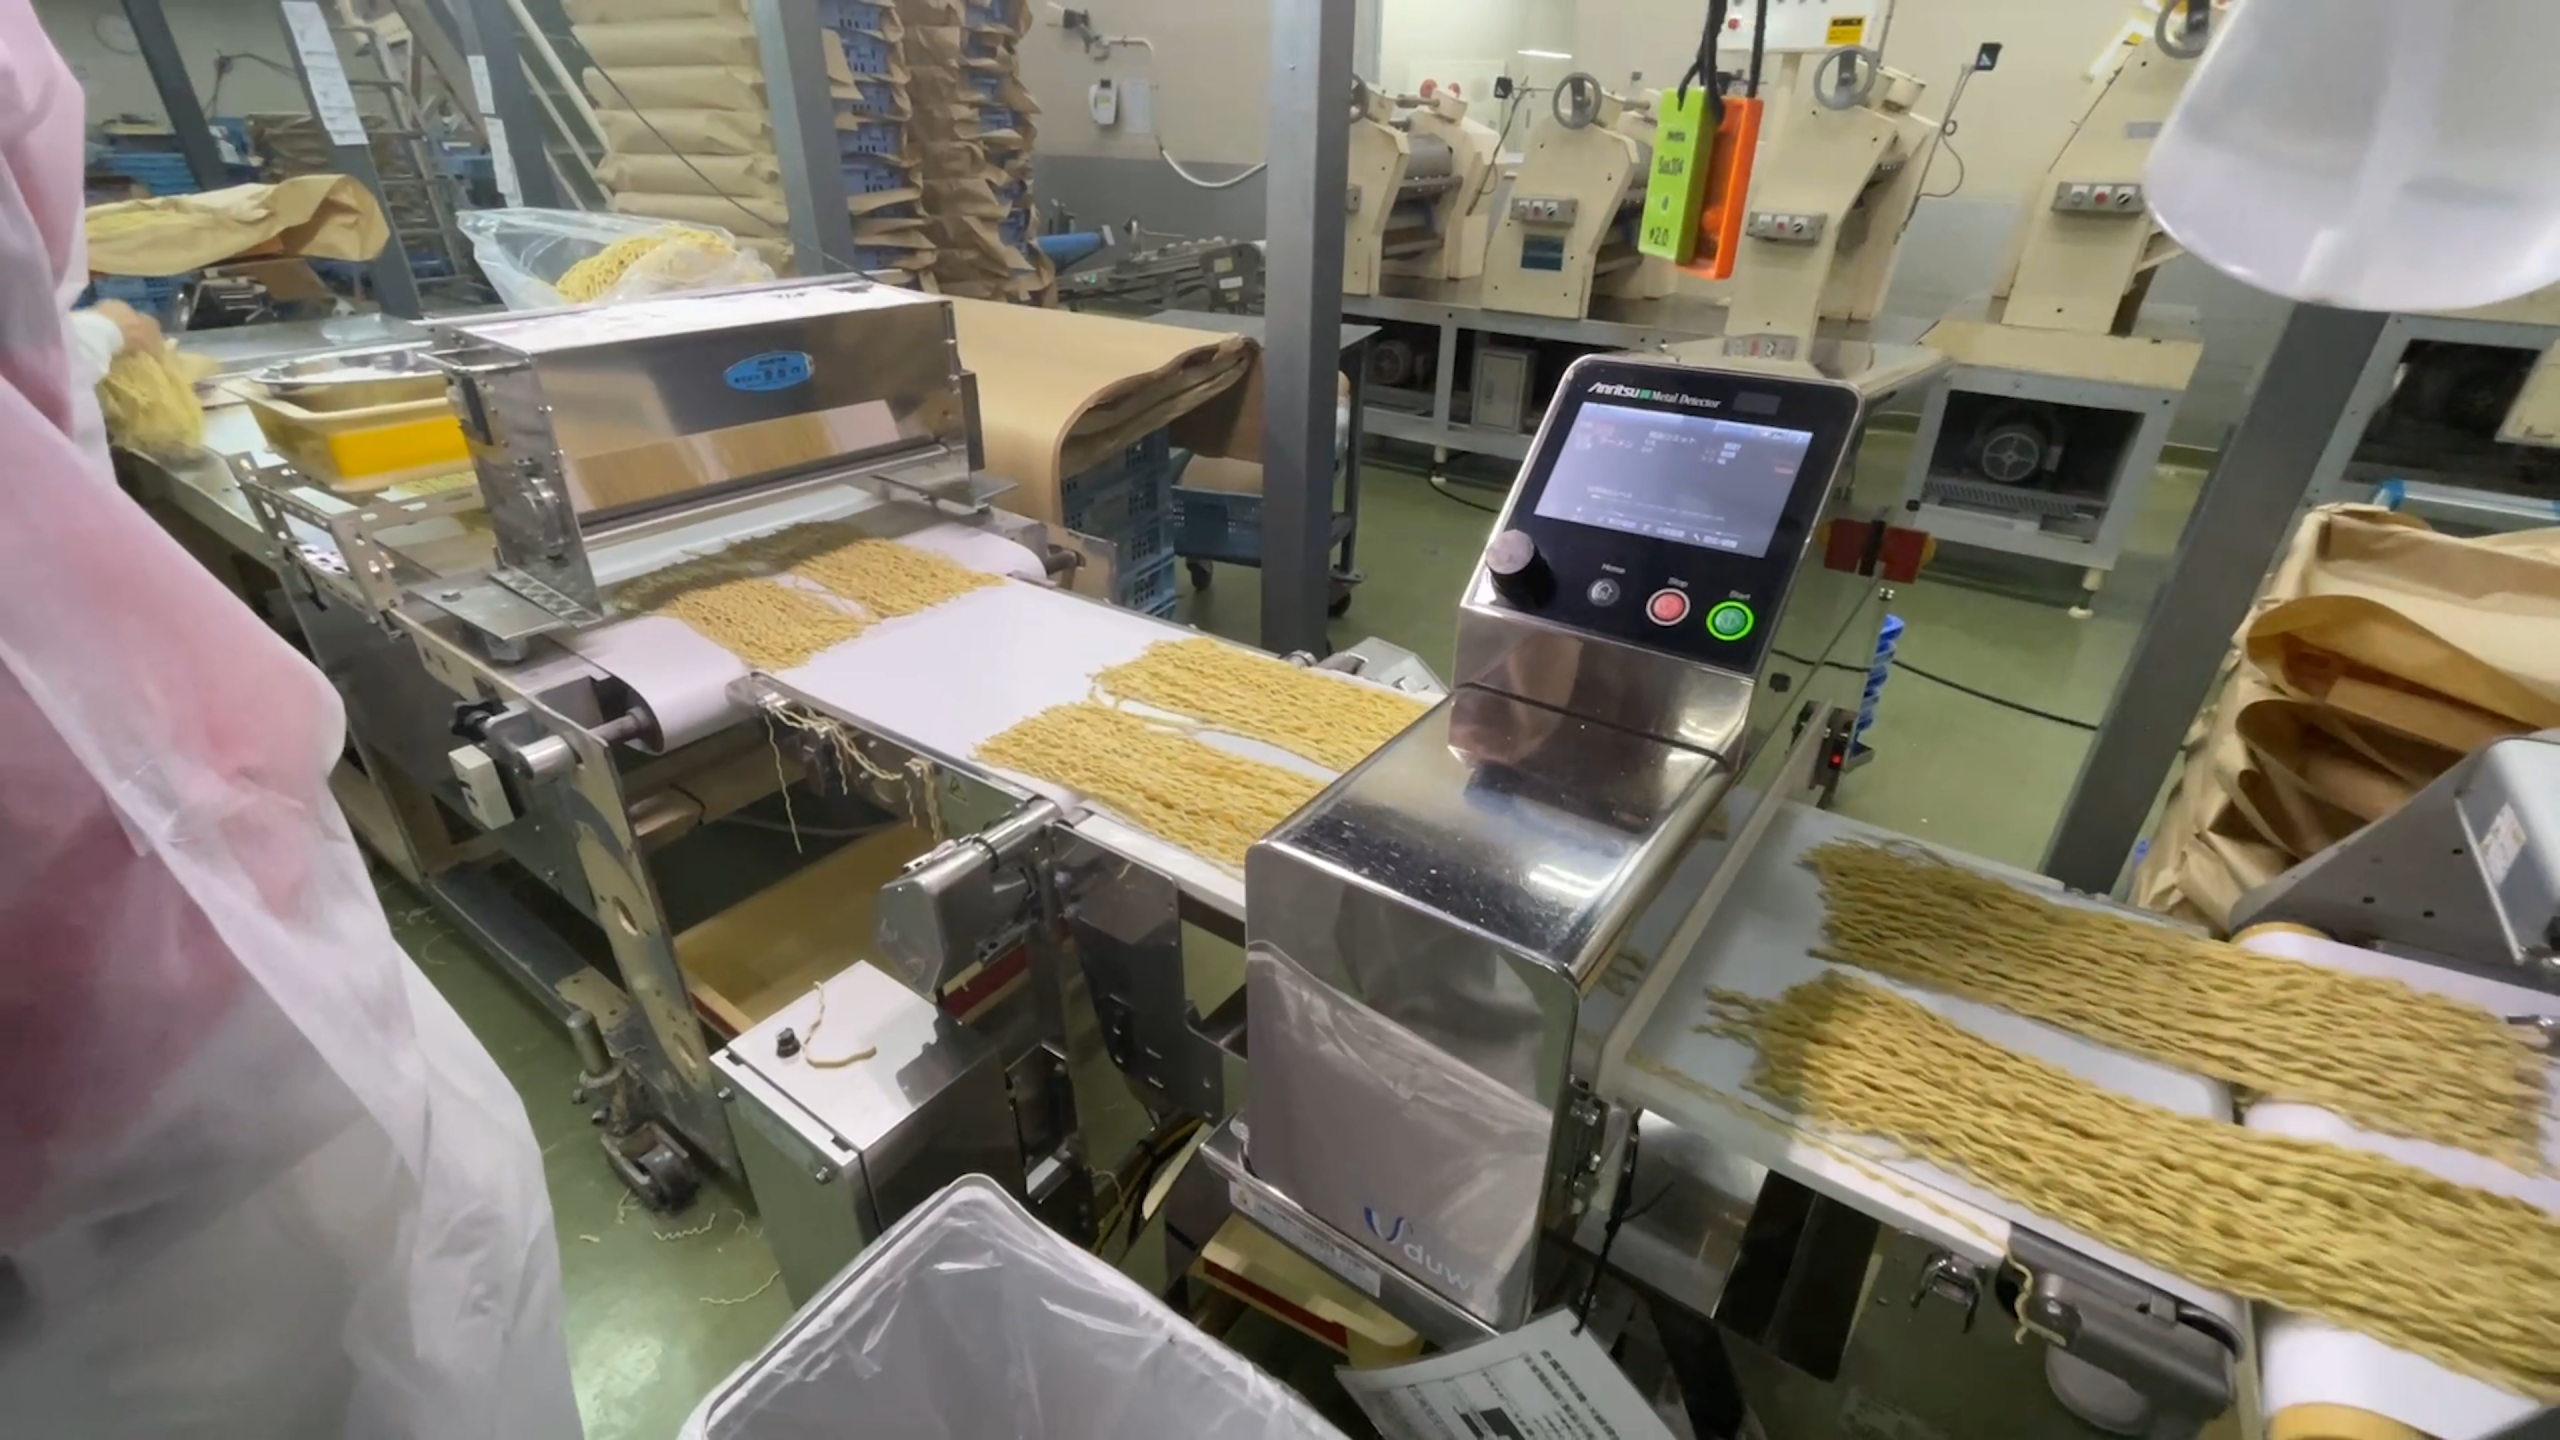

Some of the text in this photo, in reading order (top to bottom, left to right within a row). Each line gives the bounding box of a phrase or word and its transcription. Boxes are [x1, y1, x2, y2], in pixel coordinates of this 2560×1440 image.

[1587, 381, 1722, 409] Anritsu Metal Detector
[1601, 563, 1627, 575] Home
[1668, 576, 1689, 589] Stop
[1729, 589, 1752, 601] Start
